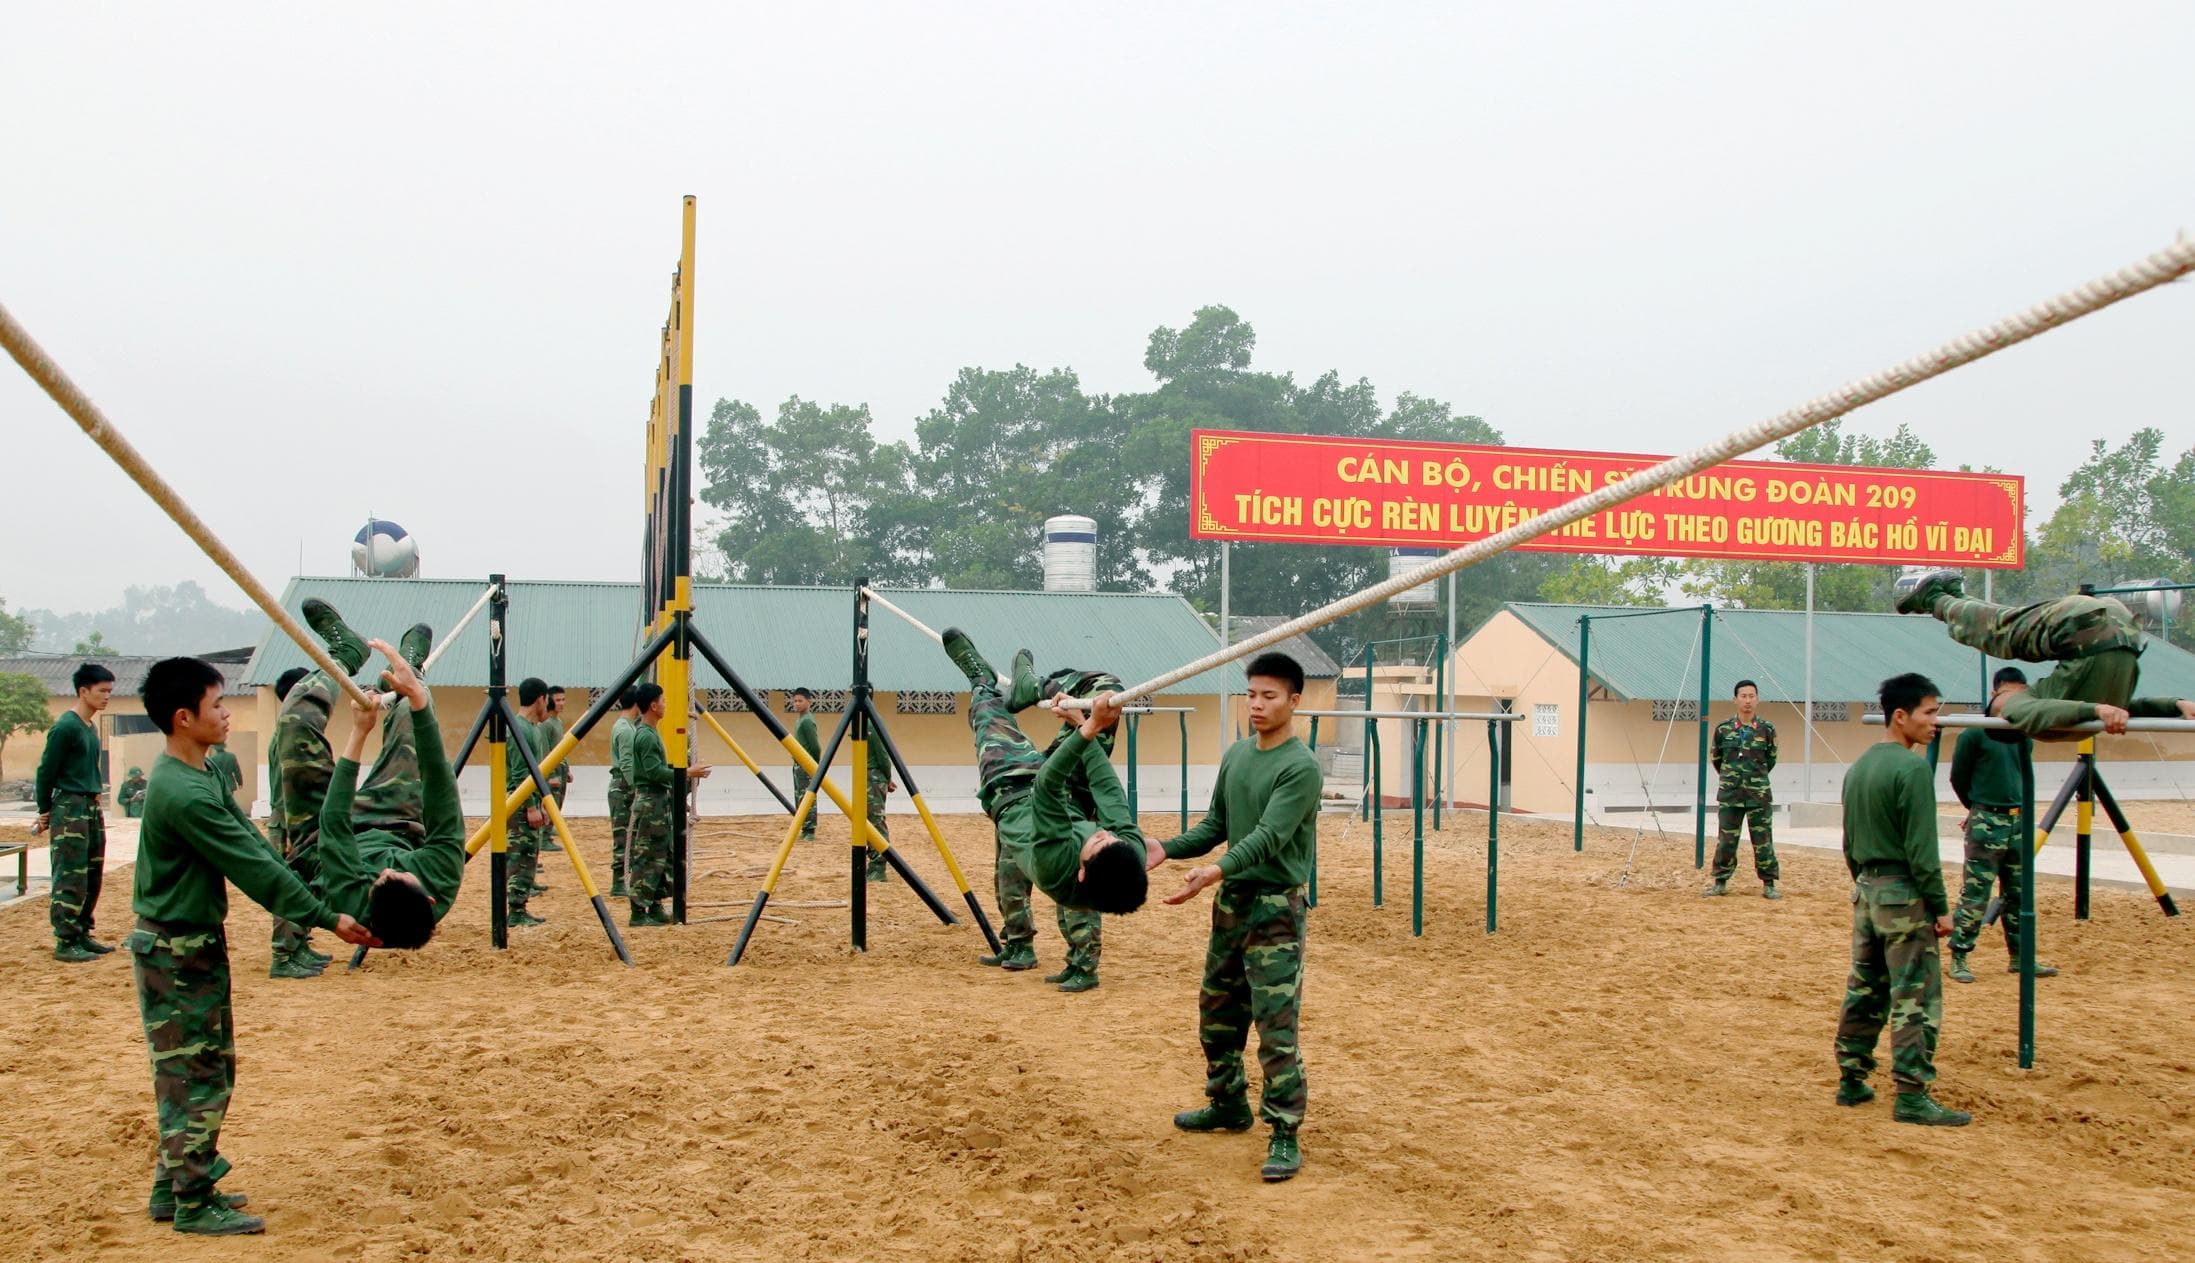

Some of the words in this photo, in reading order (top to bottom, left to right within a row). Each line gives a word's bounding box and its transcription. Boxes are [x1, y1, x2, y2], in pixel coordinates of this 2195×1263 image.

[1338, 453, 1408, 485] CÁN
[1423, 457, 1482, 493] BỘ,
[1493, 461, 1592, 496] CHIẾN
[1650, 475, 1756, 502] RUNG
[1766, 477, 1855, 507] ĐOÀN
[1867, 485, 1917, 509] 209
[1235, 489, 1302, 525] TÍCH
[1313, 497, 1372, 533] CỰC
[1383, 495, 1439, 532] RÈN
[1606, 509, 1656, 545] LỰC
[1664, 514, 1728, 543] THEO
[1737, 516, 1822, 547] GƯƠNG
[1831, 517, 1878, 549] BÁC
[1887, 516, 1918, 550] HỒ
[1926, 520, 1949, 552] VĨ
[1954, 526, 1992, 559] ĐẠI
